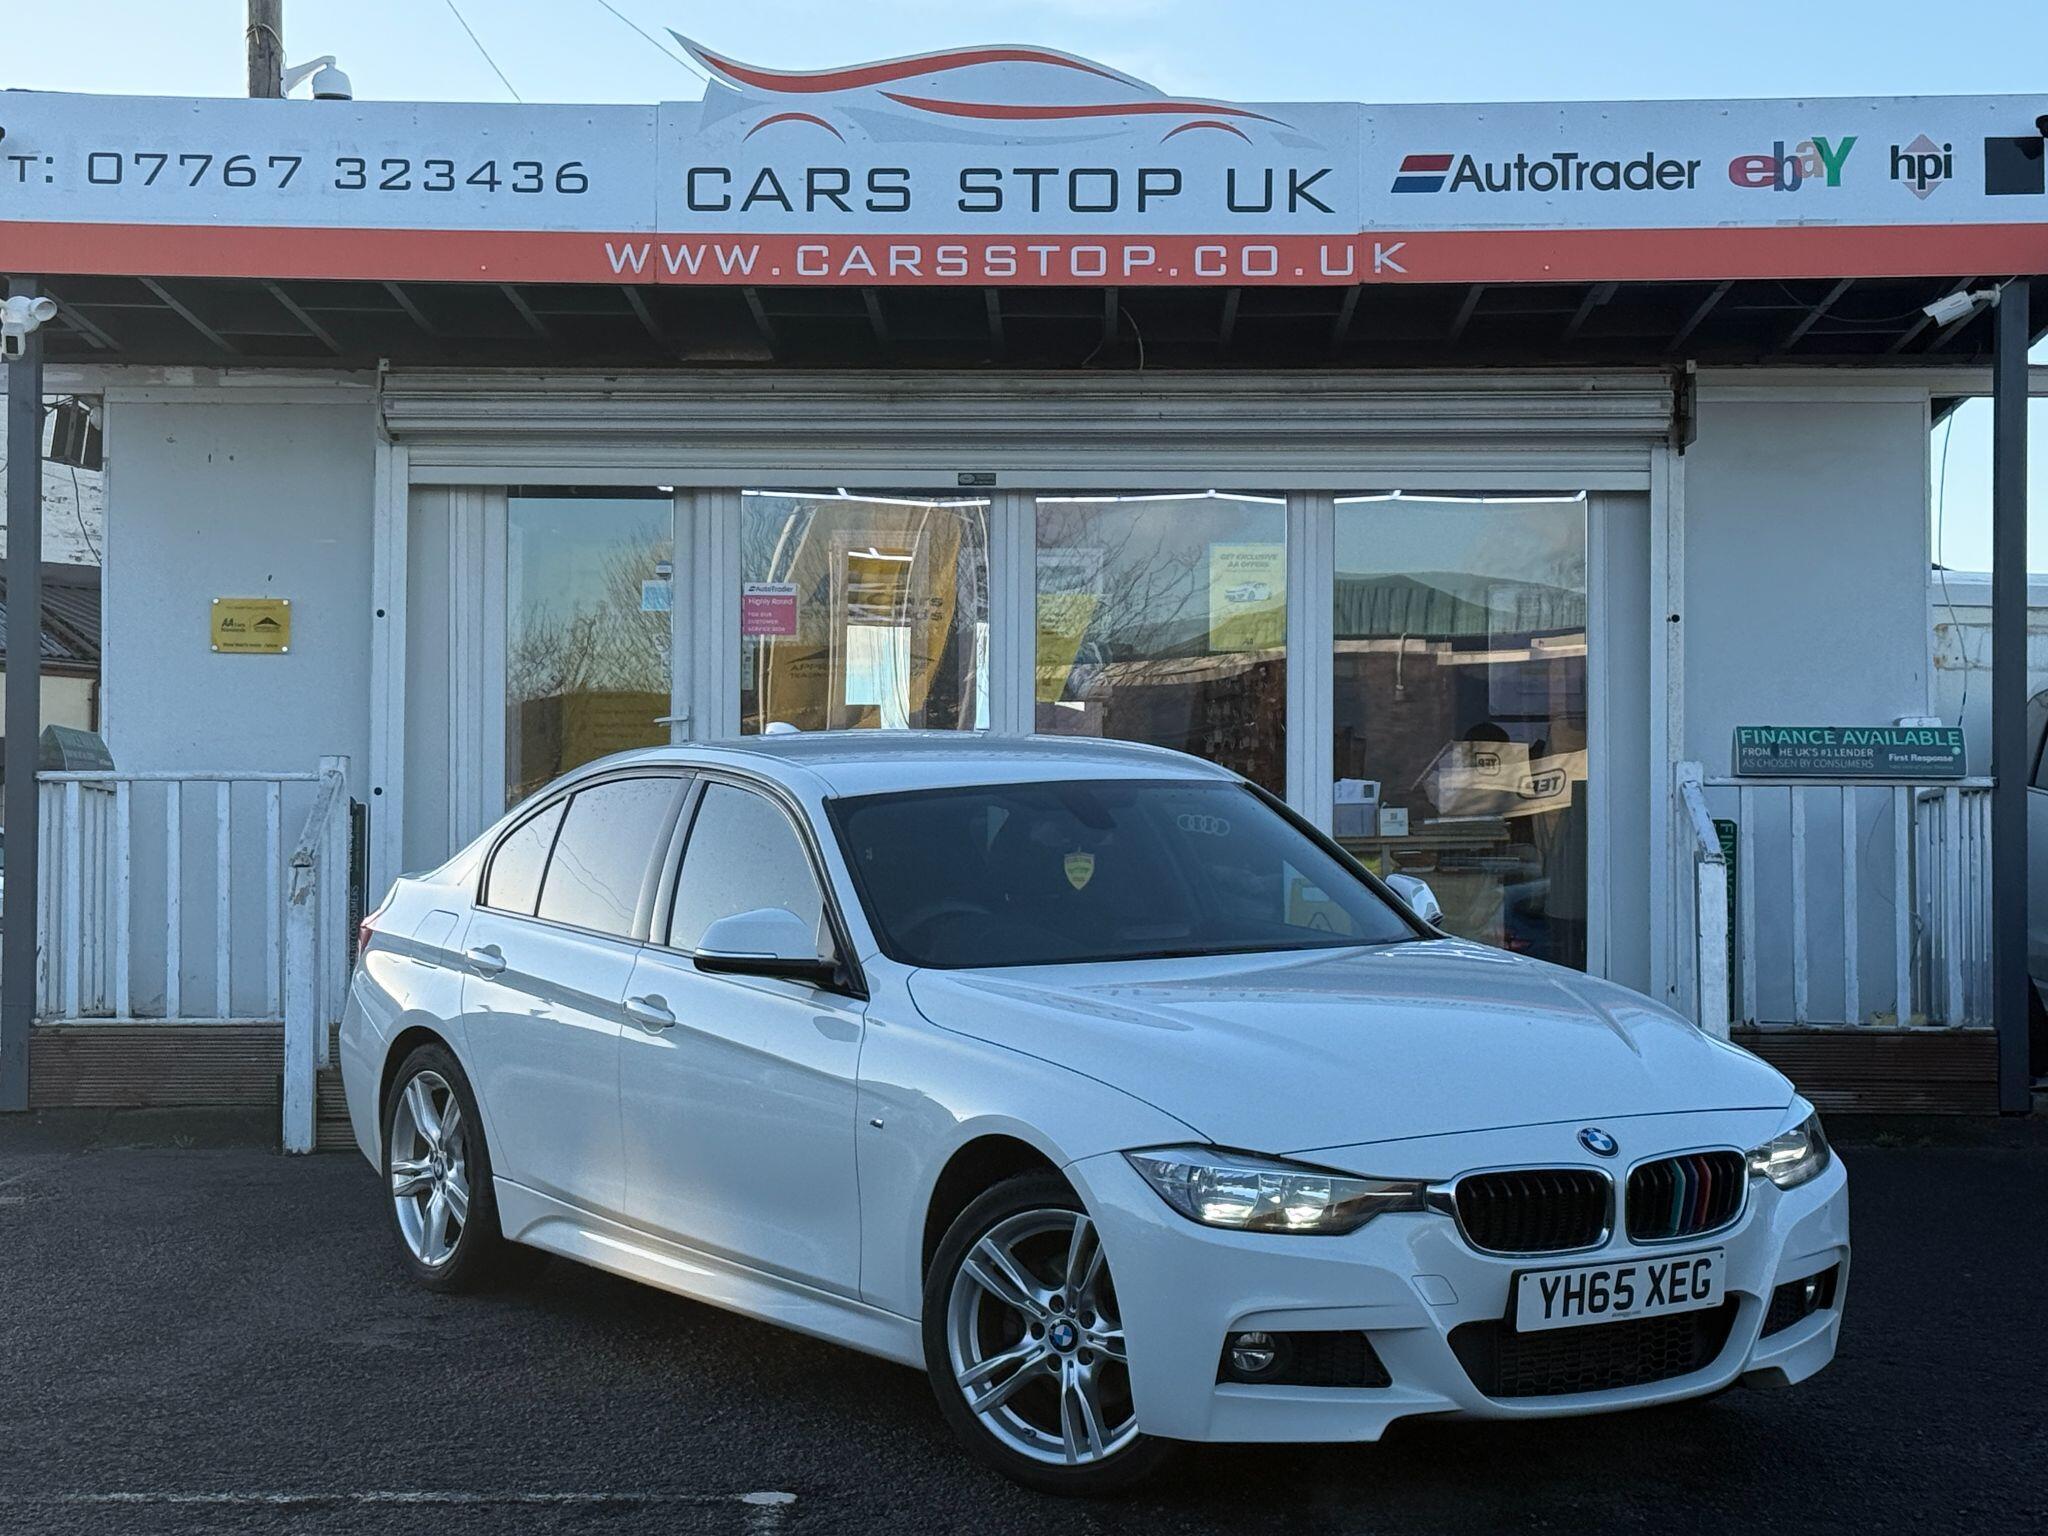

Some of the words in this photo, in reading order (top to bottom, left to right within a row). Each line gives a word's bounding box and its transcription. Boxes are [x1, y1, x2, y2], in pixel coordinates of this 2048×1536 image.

[8, 155, 54, 184] T:
[87, 152, 304, 189] 07767
[334, 157, 590, 194] 323436
[1450, 151, 1702, 193] AutoTrader
[1890, 142, 1953, 191] hpi
[687, 166, 911, 213] CARS
[957, 167, 1183, 213] STOP
[1227, 167, 1337, 214] UK
[603, 242, 1408, 278] WWW.CARSSTOP.CO.UK
[1220, 553, 1235, 561] GET
[1236, 553, 1278, 561] EXCLUSIVE
[1240, 561, 1271, 569] OFFERS
[1740, 729, 1838, 745] FINANCE
[1842, 730, 1961, 746] AVAILABLE
[1742, 747, 1771, 757] FROM
[1794, 747, 1818, 757] UK'S
[1834, 747, 1874, 758] LENDER
[1756, 758, 1797, 769] CHOSEN
[1799, 759, 1812, 769] BY
[1813, 759, 1875, 769] CONSUMERS
[1888, 753, 1908, 763] First
[1910, 754, 1955, 765] Response
[1539, 1267, 1637, 1320] YH65
[1645, 1257, 1712, 1308] XEG
